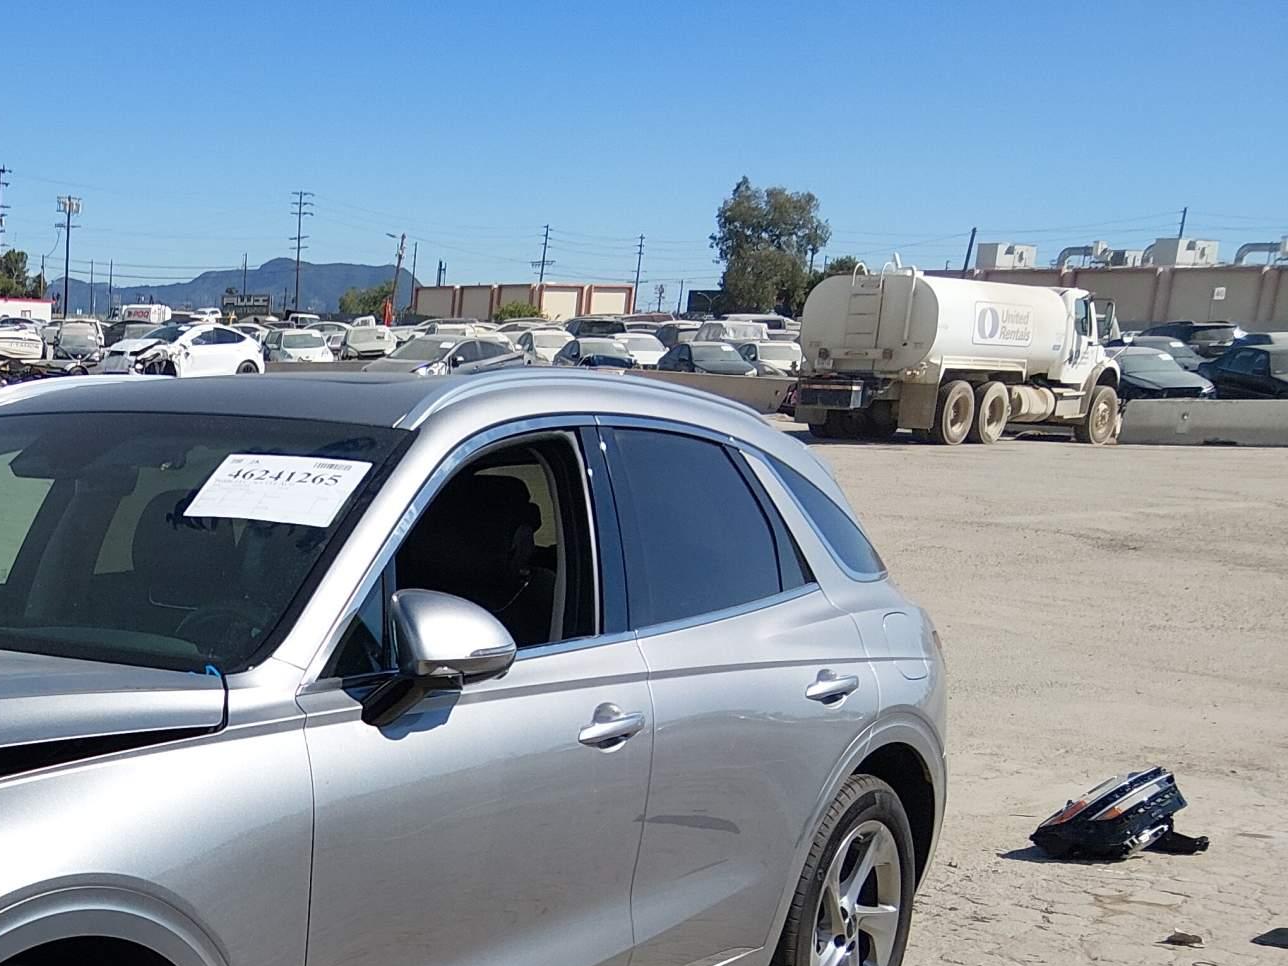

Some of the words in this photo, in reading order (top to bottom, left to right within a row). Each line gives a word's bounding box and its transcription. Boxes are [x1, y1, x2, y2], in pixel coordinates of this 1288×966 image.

[1002, 309, 1030, 325] United
[1000, 326, 1030, 341] Rentals
[227, 468, 342, 487] 46241265
